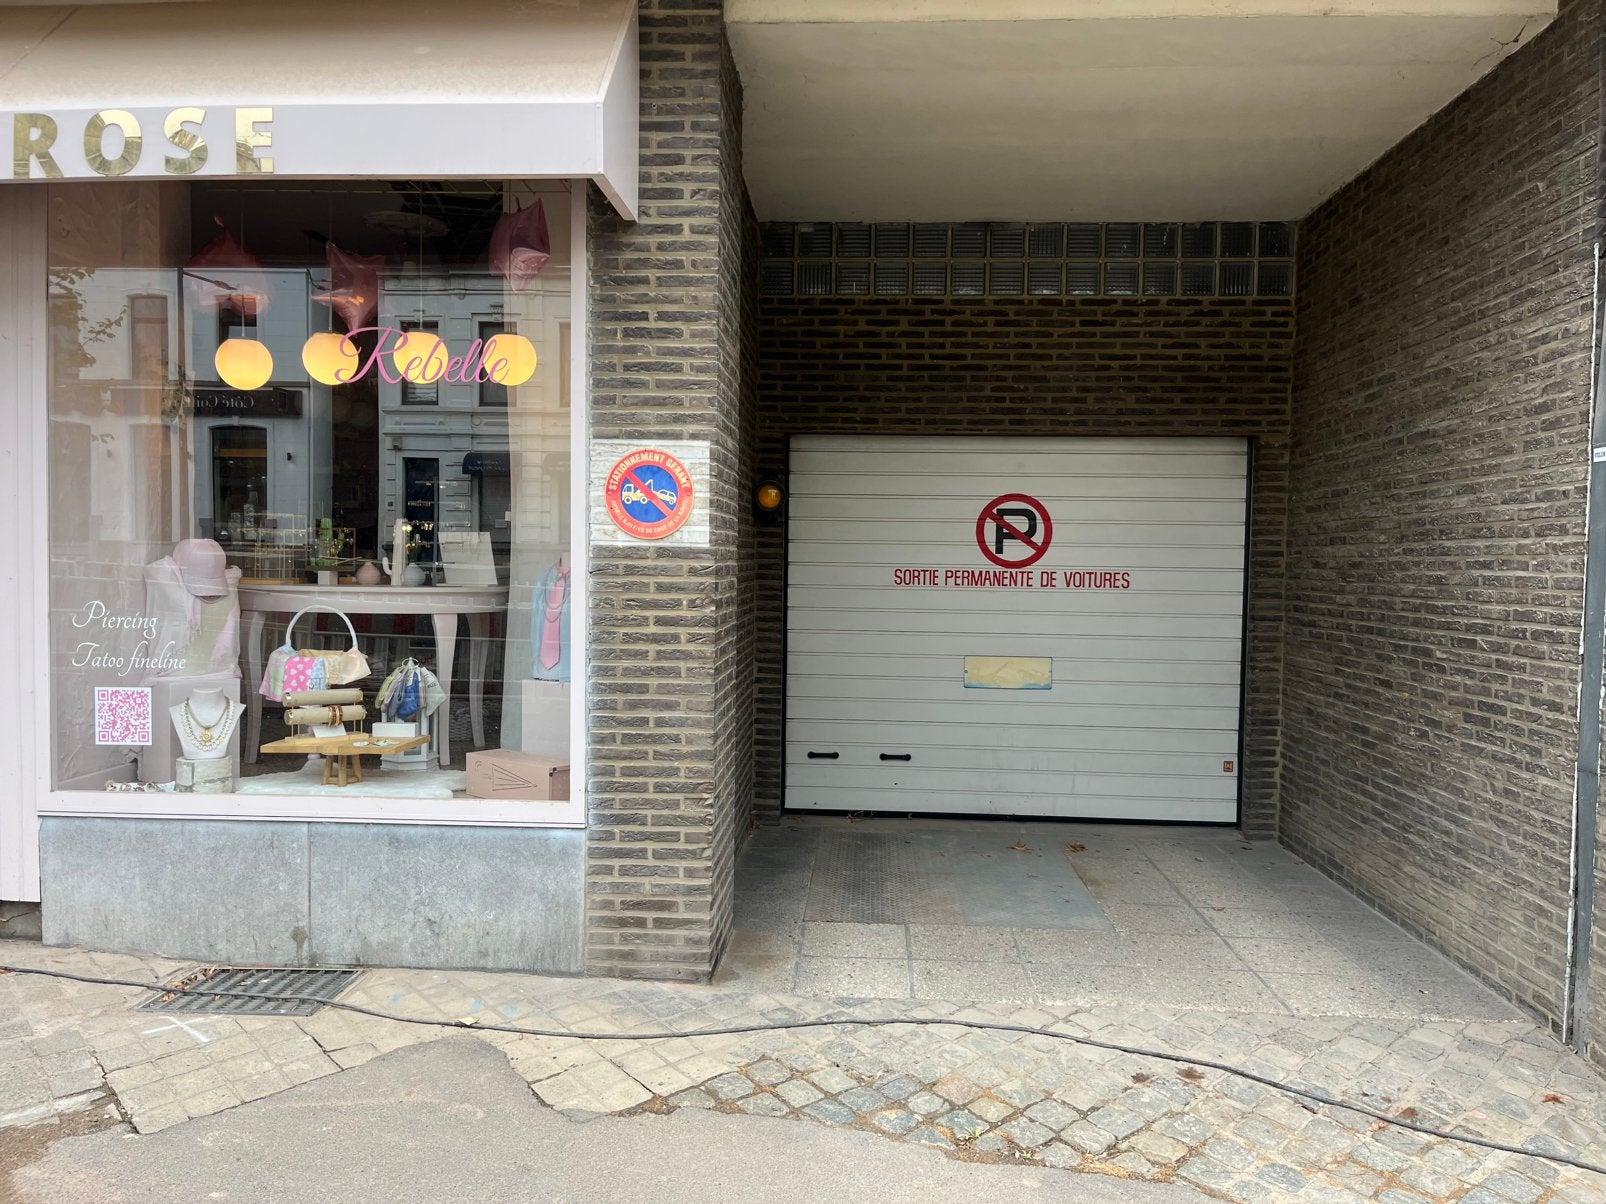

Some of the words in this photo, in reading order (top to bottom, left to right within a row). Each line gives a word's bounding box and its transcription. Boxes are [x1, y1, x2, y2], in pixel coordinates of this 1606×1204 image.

[12, 107, 276, 179] ROSE
[334, 326, 511, 385] Rebelle
[609, 452, 666, 490] STATIONNEMENT
[666, 458, 690, 488] GENANT
[894, 568, 939, 586] SORTIE
[944, 569, 1034, 588] PERMANENTE
[1040, 571, 1057, 588] DE
[1063, 571, 1131, 589] VOITURES
[71, 600, 158, 639] Piercing
[72, 642, 124, 667] Tatoo
[118, 641, 187, 677] fineline
